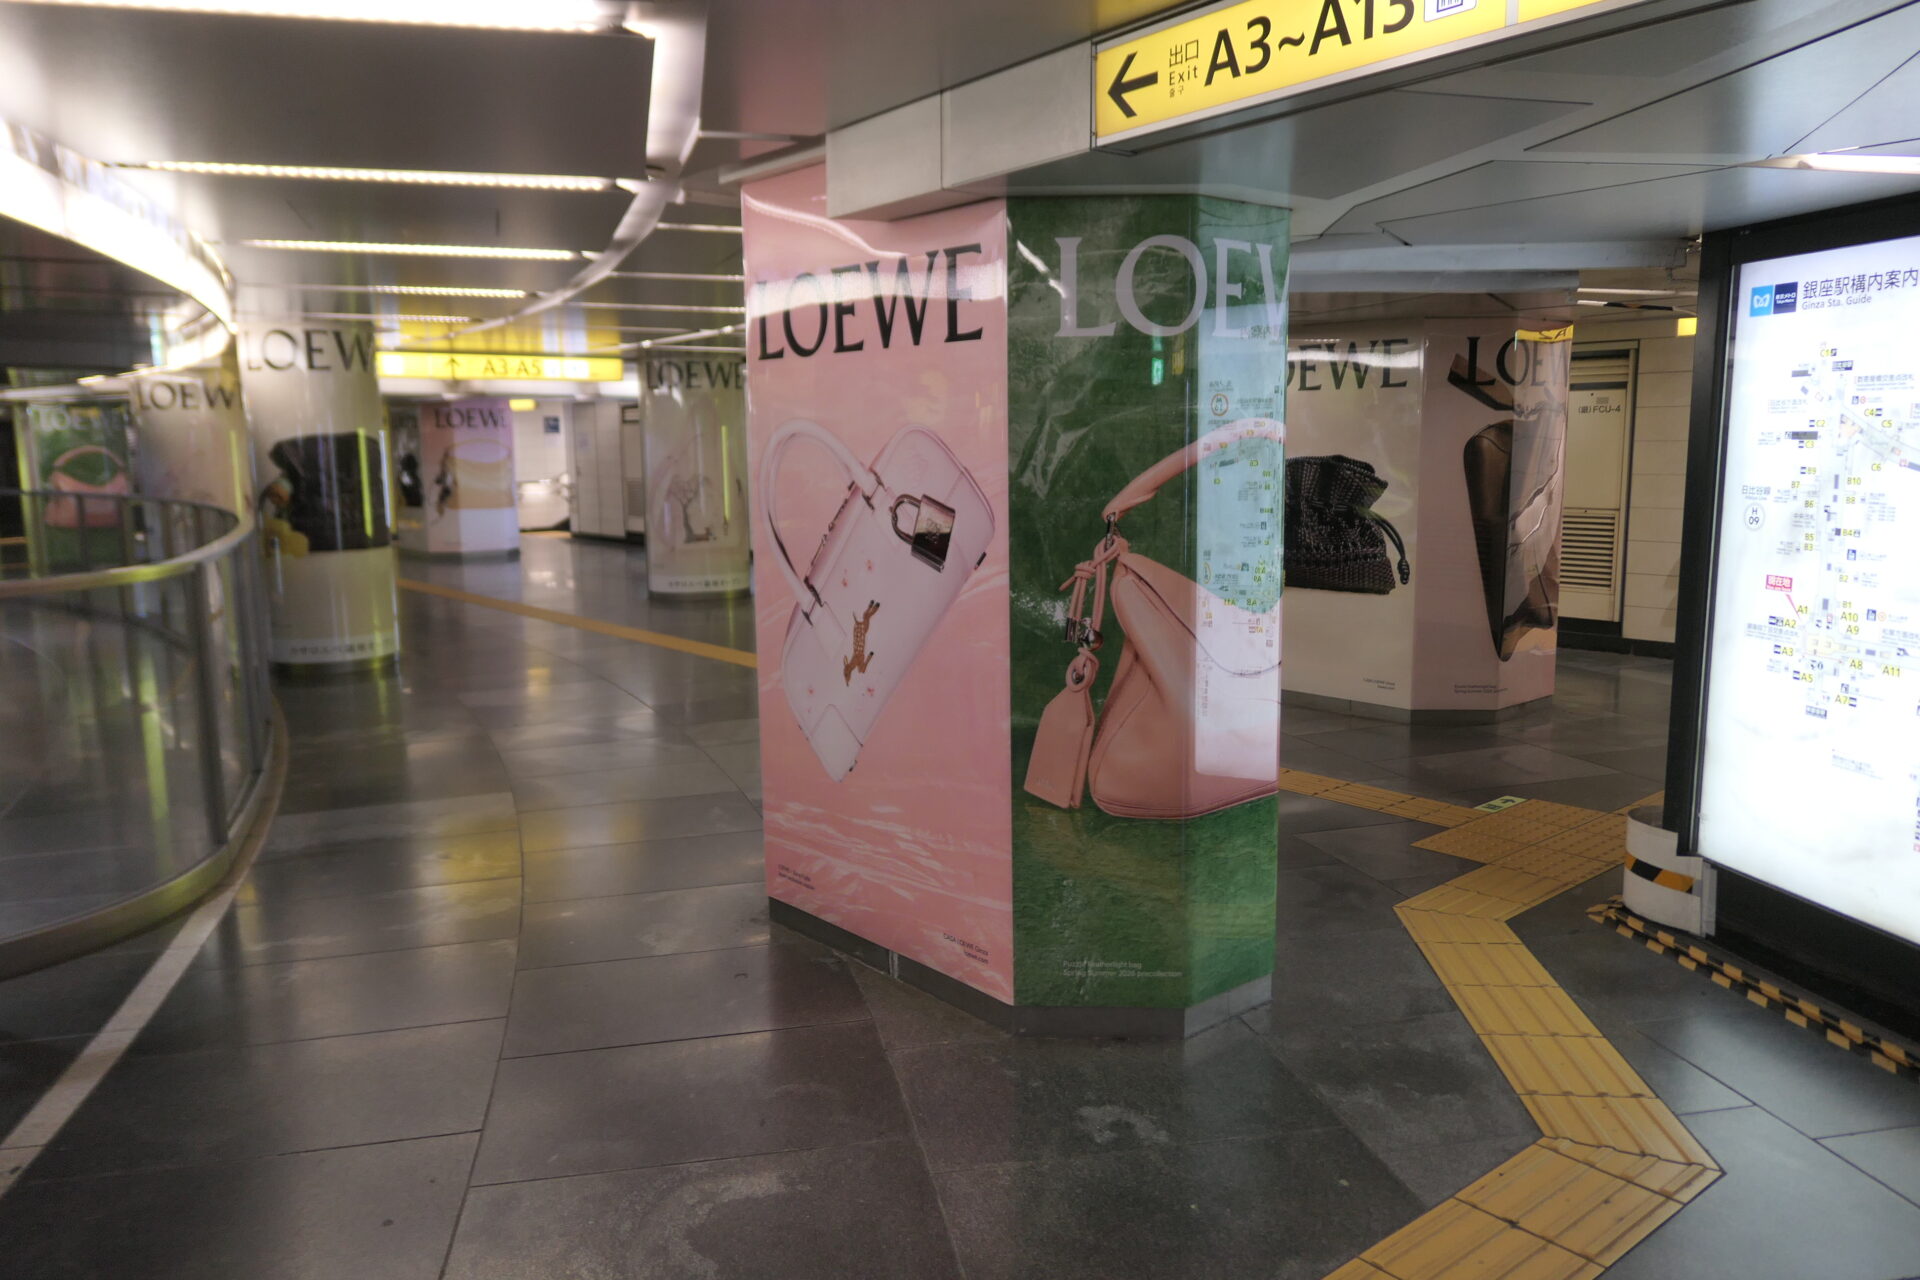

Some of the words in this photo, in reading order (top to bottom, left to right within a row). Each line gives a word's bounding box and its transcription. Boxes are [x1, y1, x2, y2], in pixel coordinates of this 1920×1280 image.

[1169, 40, 1199, 68] 出口
[1169, 65, 1198, 86] Exit
[1802, 267, 1919, 299] 銀座駅構内案内
[758, 243, 983, 360] LOEWE
[1802, 300, 1825, 311] Ginza
[1827, 298, 1843, 308] Sta.
[1846, 294, 1872, 306] Guide
[1847, 477, 1861, 485] B10
[1749, 516, 1760, 526] 09
[1797, 605, 1808, 615] A1
[1840, 611, 1859, 622] A10
[1784, 619, 1797, 629] A2
[1846, 625, 1859, 635] A9
[1781, 647, 1794, 657] A3
[1849, 659, 1863, 671] A8
[1882, 665, 1901, 678] A11
[1801, 672, 1813, 683] A5
